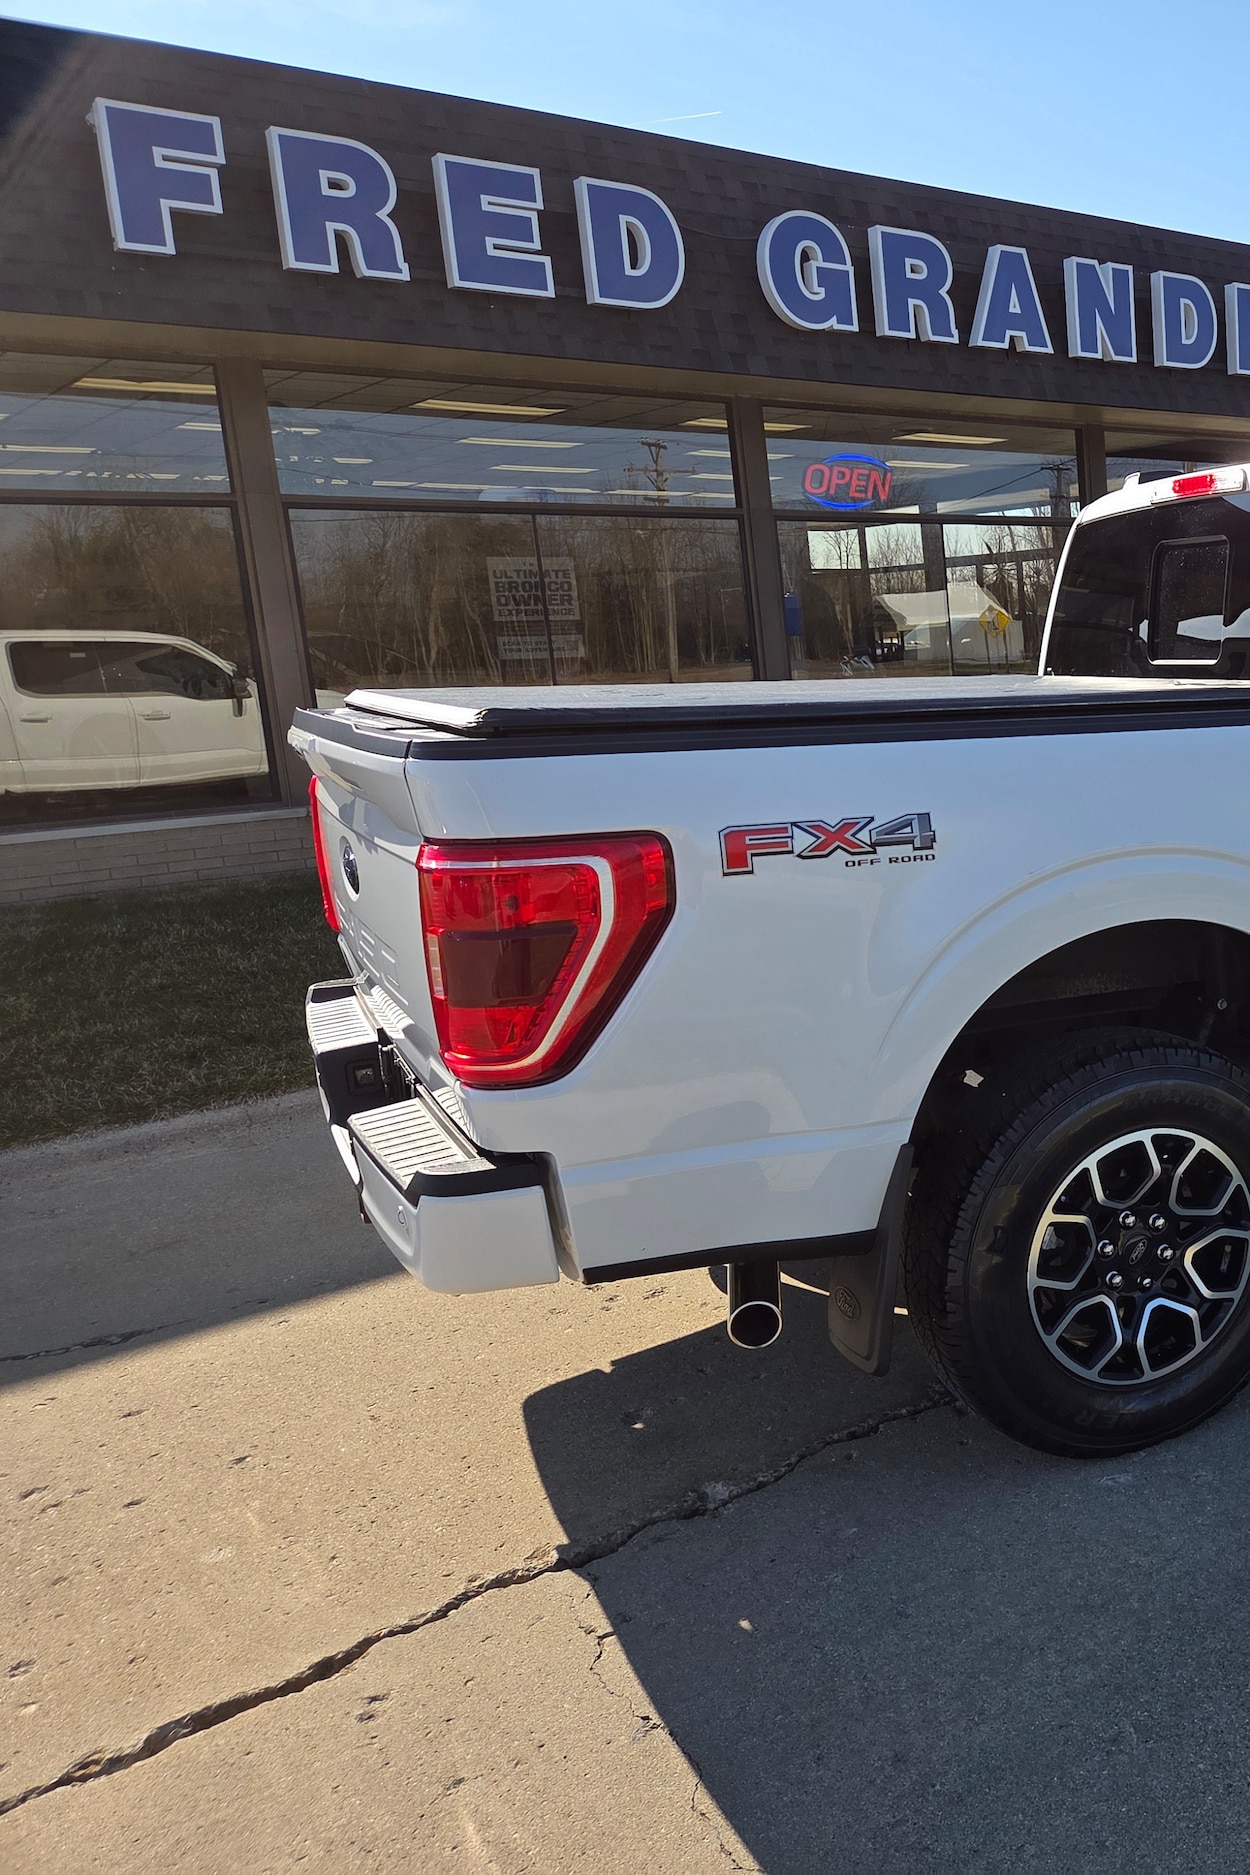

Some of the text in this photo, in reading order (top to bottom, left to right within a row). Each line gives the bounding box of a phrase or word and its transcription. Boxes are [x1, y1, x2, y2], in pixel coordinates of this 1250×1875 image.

[91, 97, 686, 310] FRED
[803, 462, 893, 502] OPEN
[492, 569, 571, 579] ULTIMATE
[496, 593, 574, 607] OWNER
[498, 607, 576, 617] EXPERIENCE
[718, 811, 937, 877] FX4
[845, 853, 936, 868] OFF ROAD
